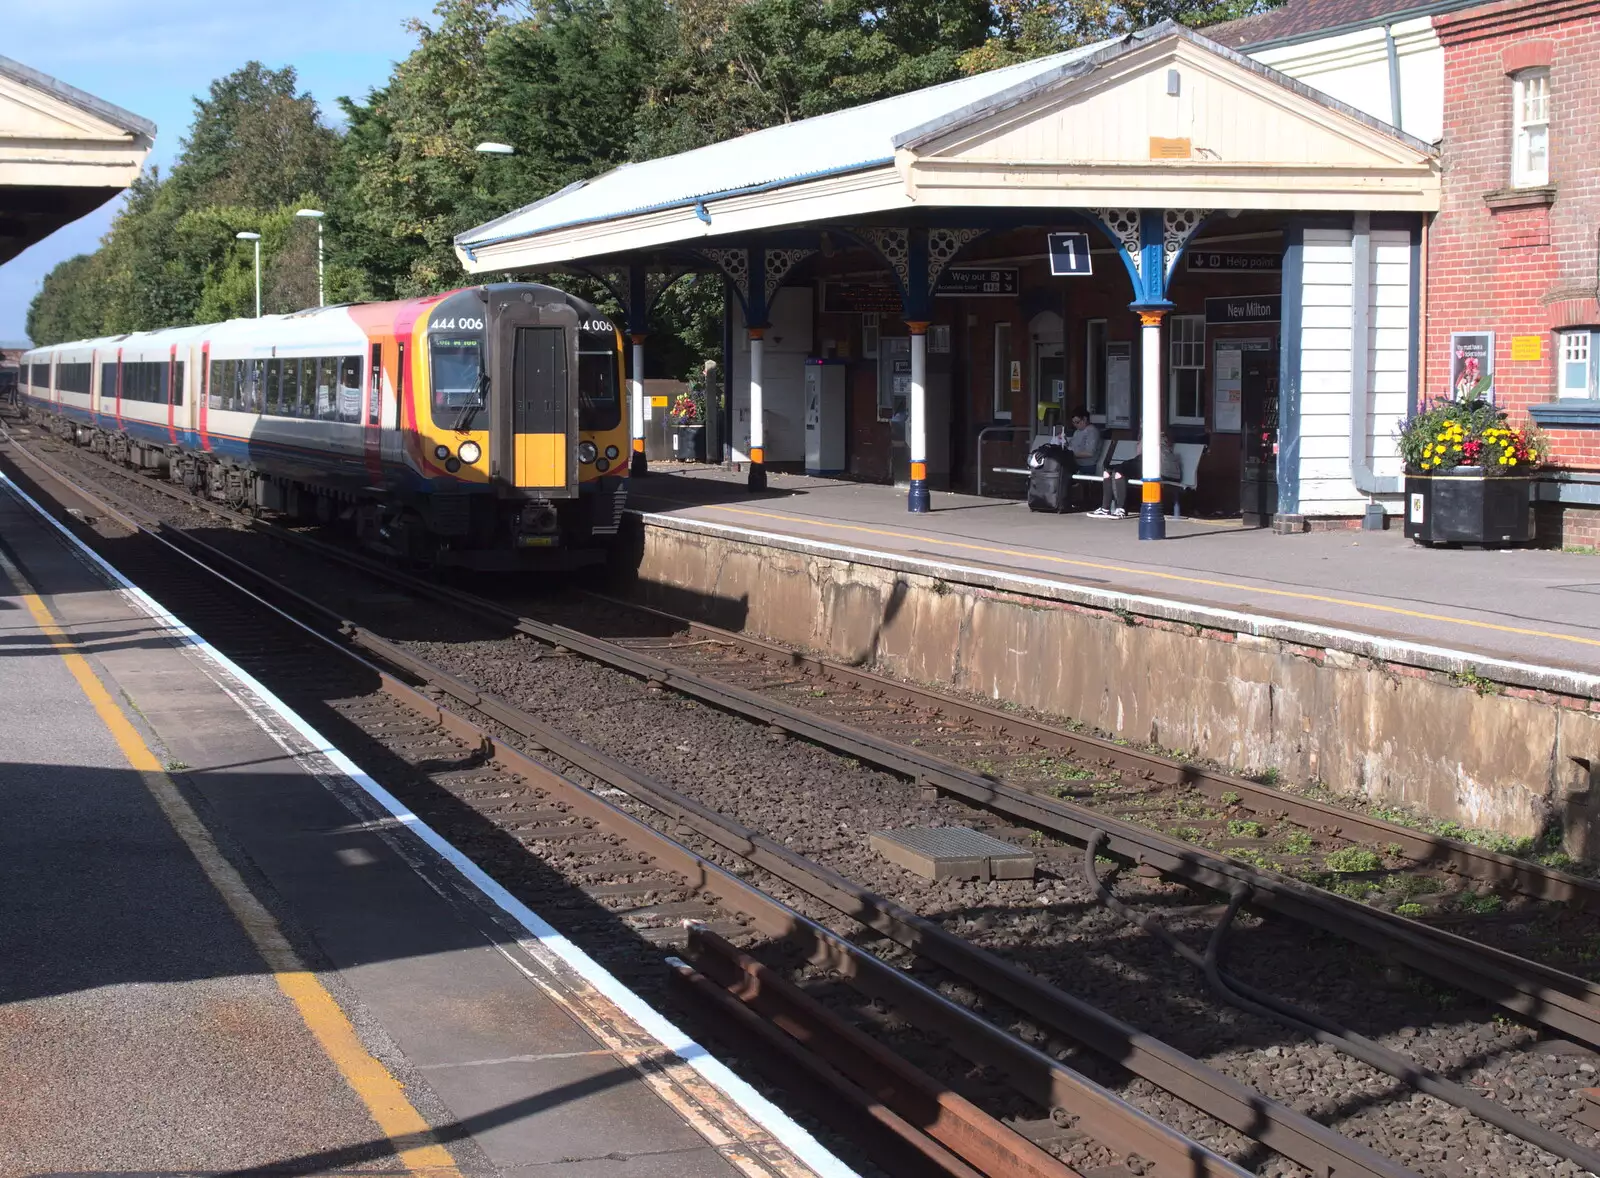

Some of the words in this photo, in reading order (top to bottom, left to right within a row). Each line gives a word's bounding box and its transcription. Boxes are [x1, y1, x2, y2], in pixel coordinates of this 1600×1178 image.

[1062, 239, 1077, 270] 1
[1226, 255, 1248, 268] Help
[1250, 256, 1275, 269] point
[951, 271, 970, 283] Way
[971, 272, 986, 281] out
[1227, 303, 1245, 317] New
[1246, 302, 1271, 317] Milton
[430, 317, 455, 329] 444
[458, 317, 484, 330] 006
[592, 319, 613, 332] 006
